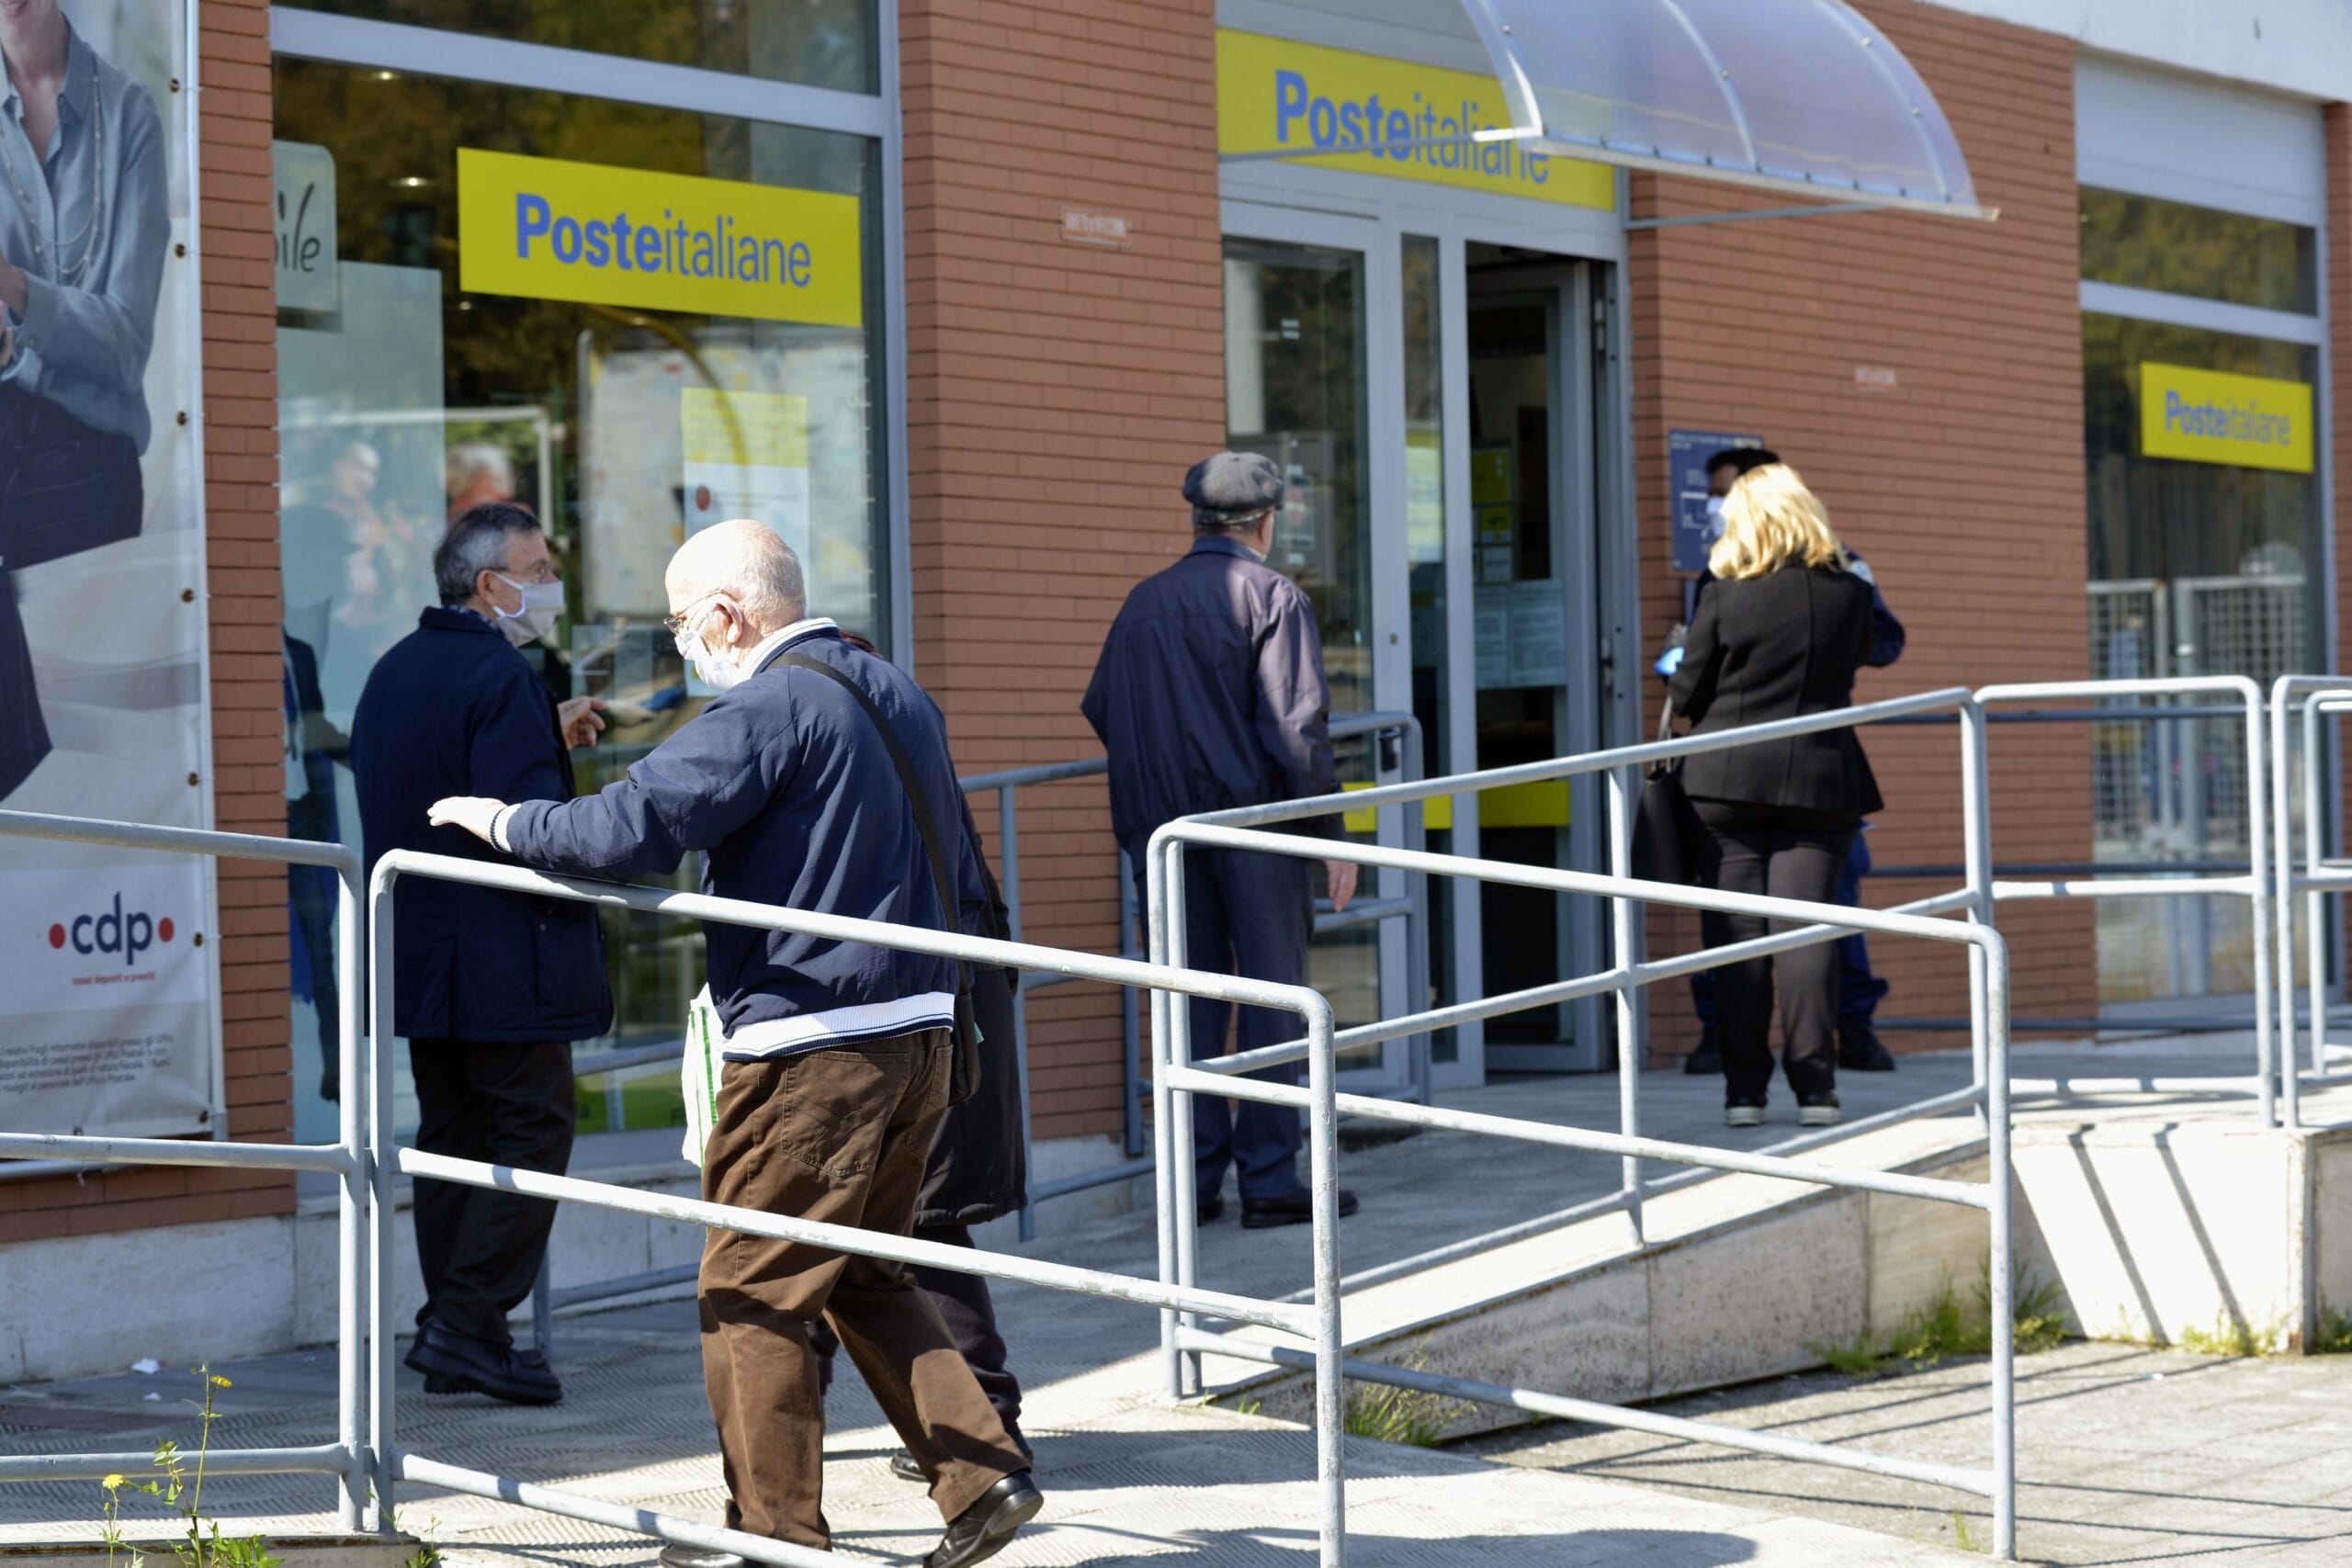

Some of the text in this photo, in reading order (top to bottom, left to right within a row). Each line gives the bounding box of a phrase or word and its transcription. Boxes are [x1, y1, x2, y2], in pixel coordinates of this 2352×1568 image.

[516, 193, 811, 288] Posteitaliane
[2165, 389, 2290, 446] Posteitaliane
[72, 890, 153, 964] cdp
